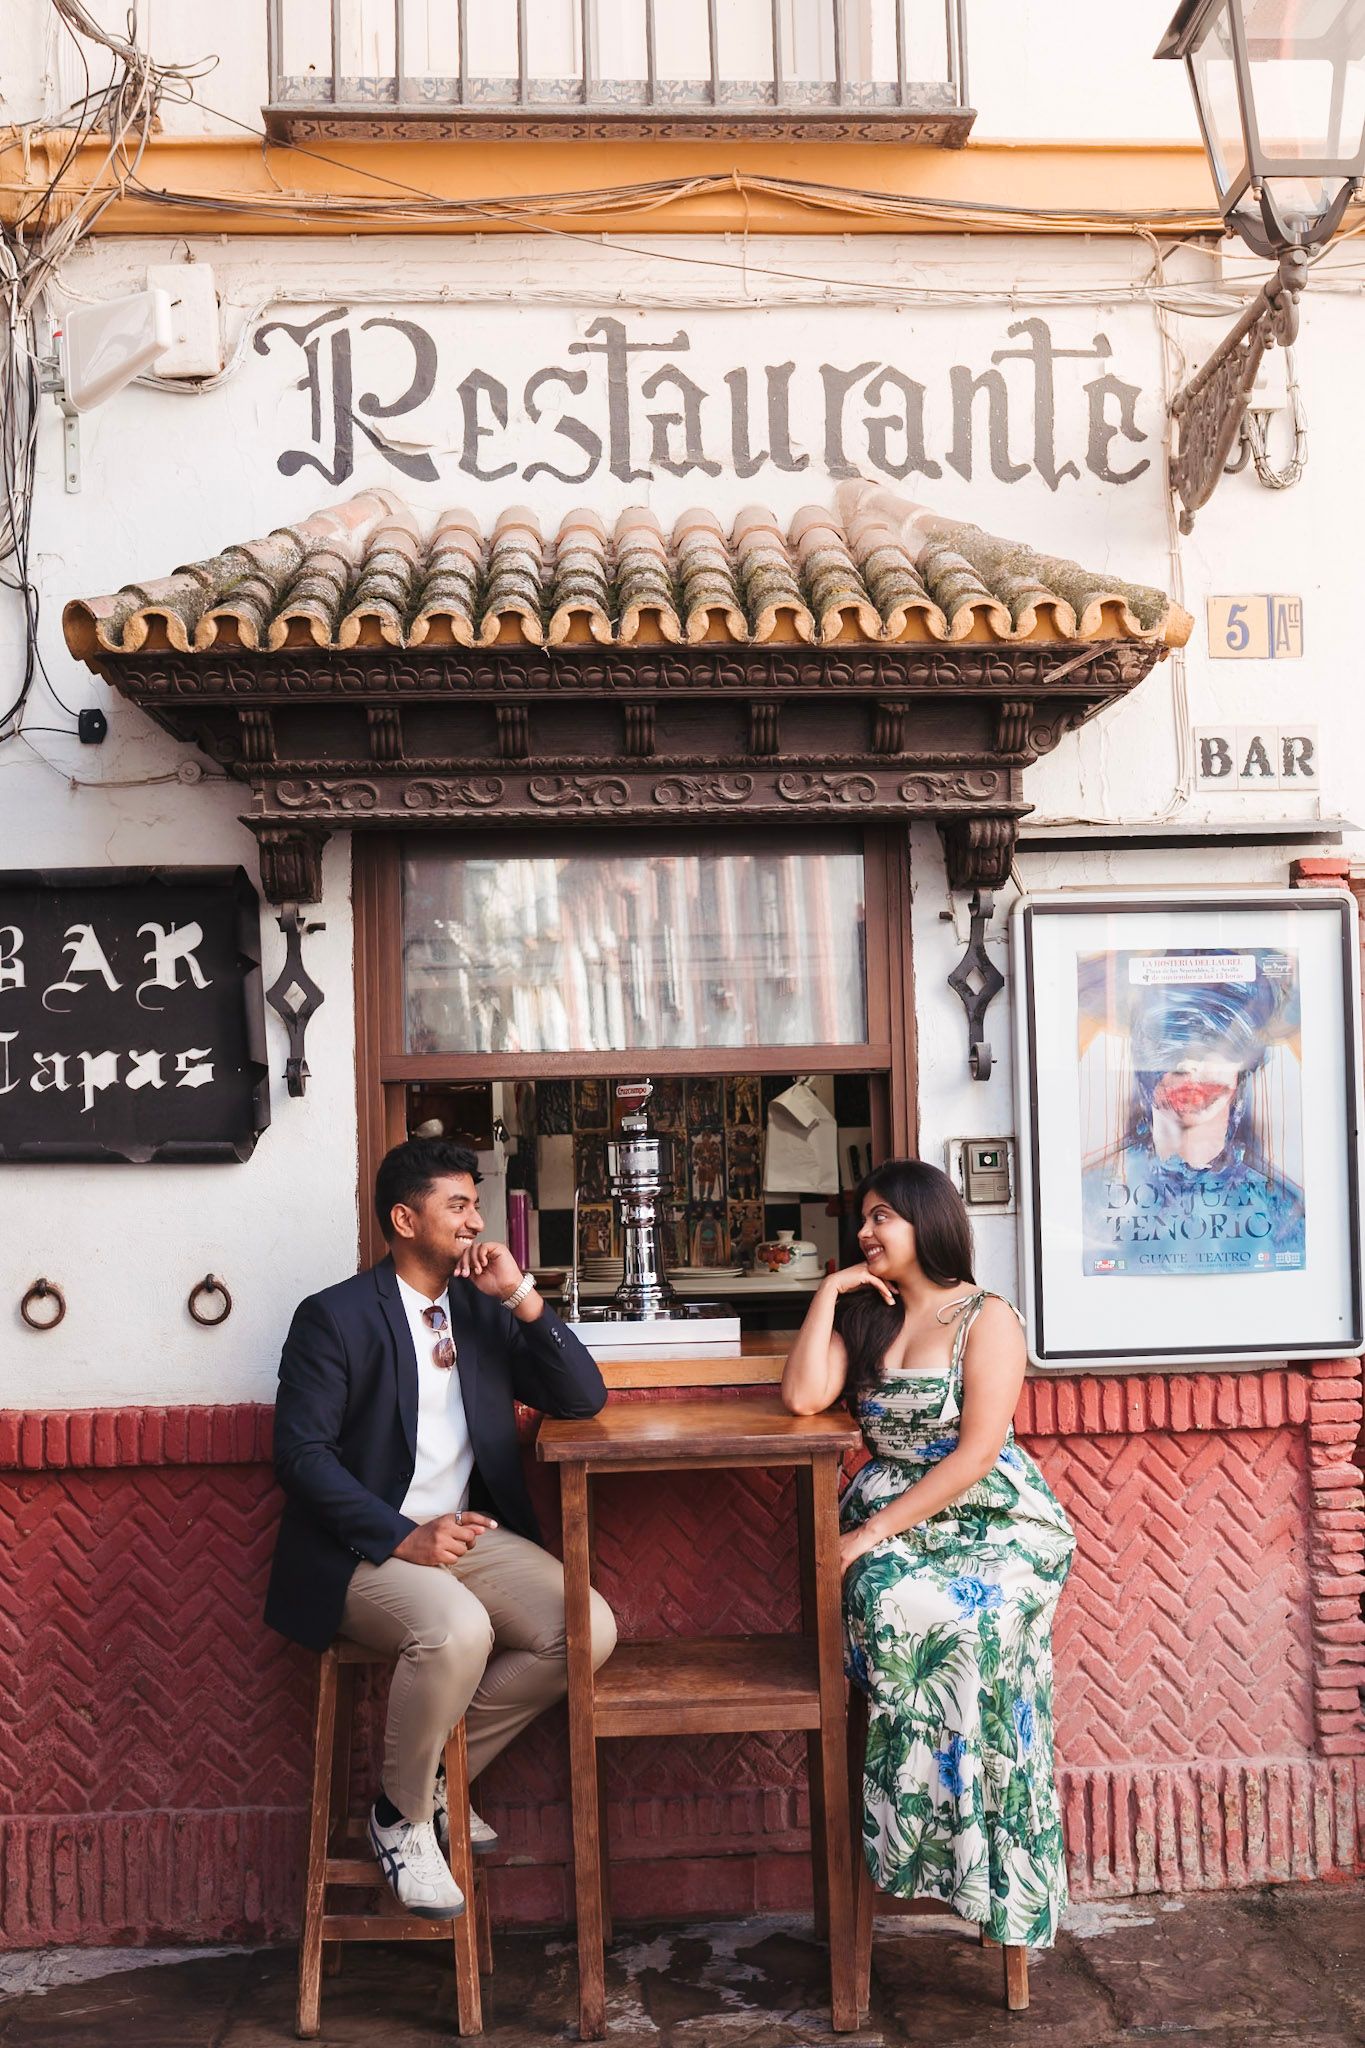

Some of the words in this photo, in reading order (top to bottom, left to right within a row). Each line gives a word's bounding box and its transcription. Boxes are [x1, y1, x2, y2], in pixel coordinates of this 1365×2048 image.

[253, 306, 1152, 492] Restaurante
[1226, 604, 1250, 651] 5
[1199, 735, 1315, 778] BAR
[1105, 1212, 1272, 1242] TENORIO
[1139, 1253, 1187, 1264] GUATE
[1196, 1251, 1251, 1262] TEATRO
